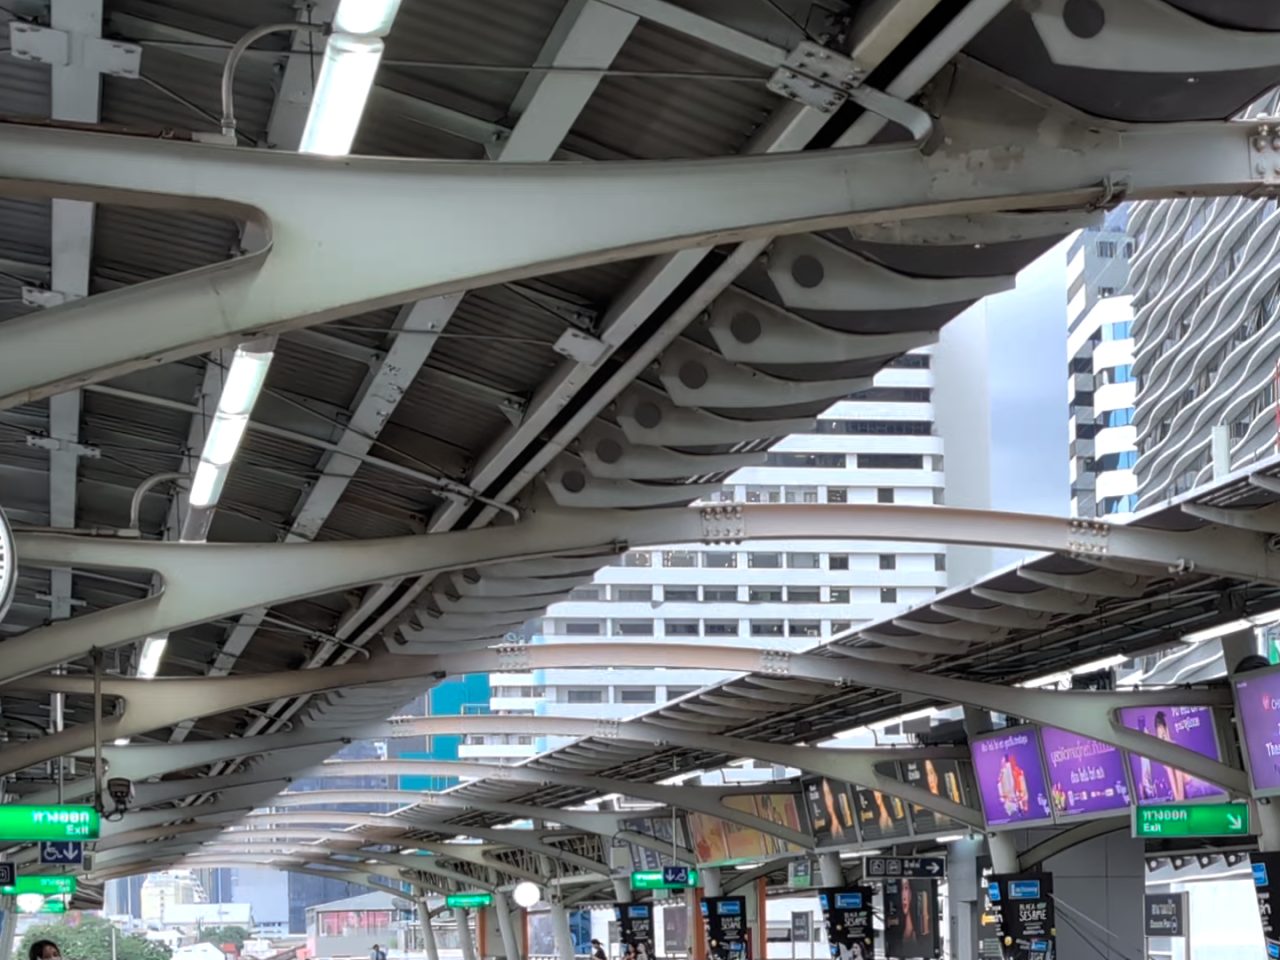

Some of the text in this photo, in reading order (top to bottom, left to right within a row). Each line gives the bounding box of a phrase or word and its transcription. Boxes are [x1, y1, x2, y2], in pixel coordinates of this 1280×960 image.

[1142, 809, 1187, 821] ทางออก
[66, 824, 89, 835] Exit
[1143, 822, 1161, 832] Exit
